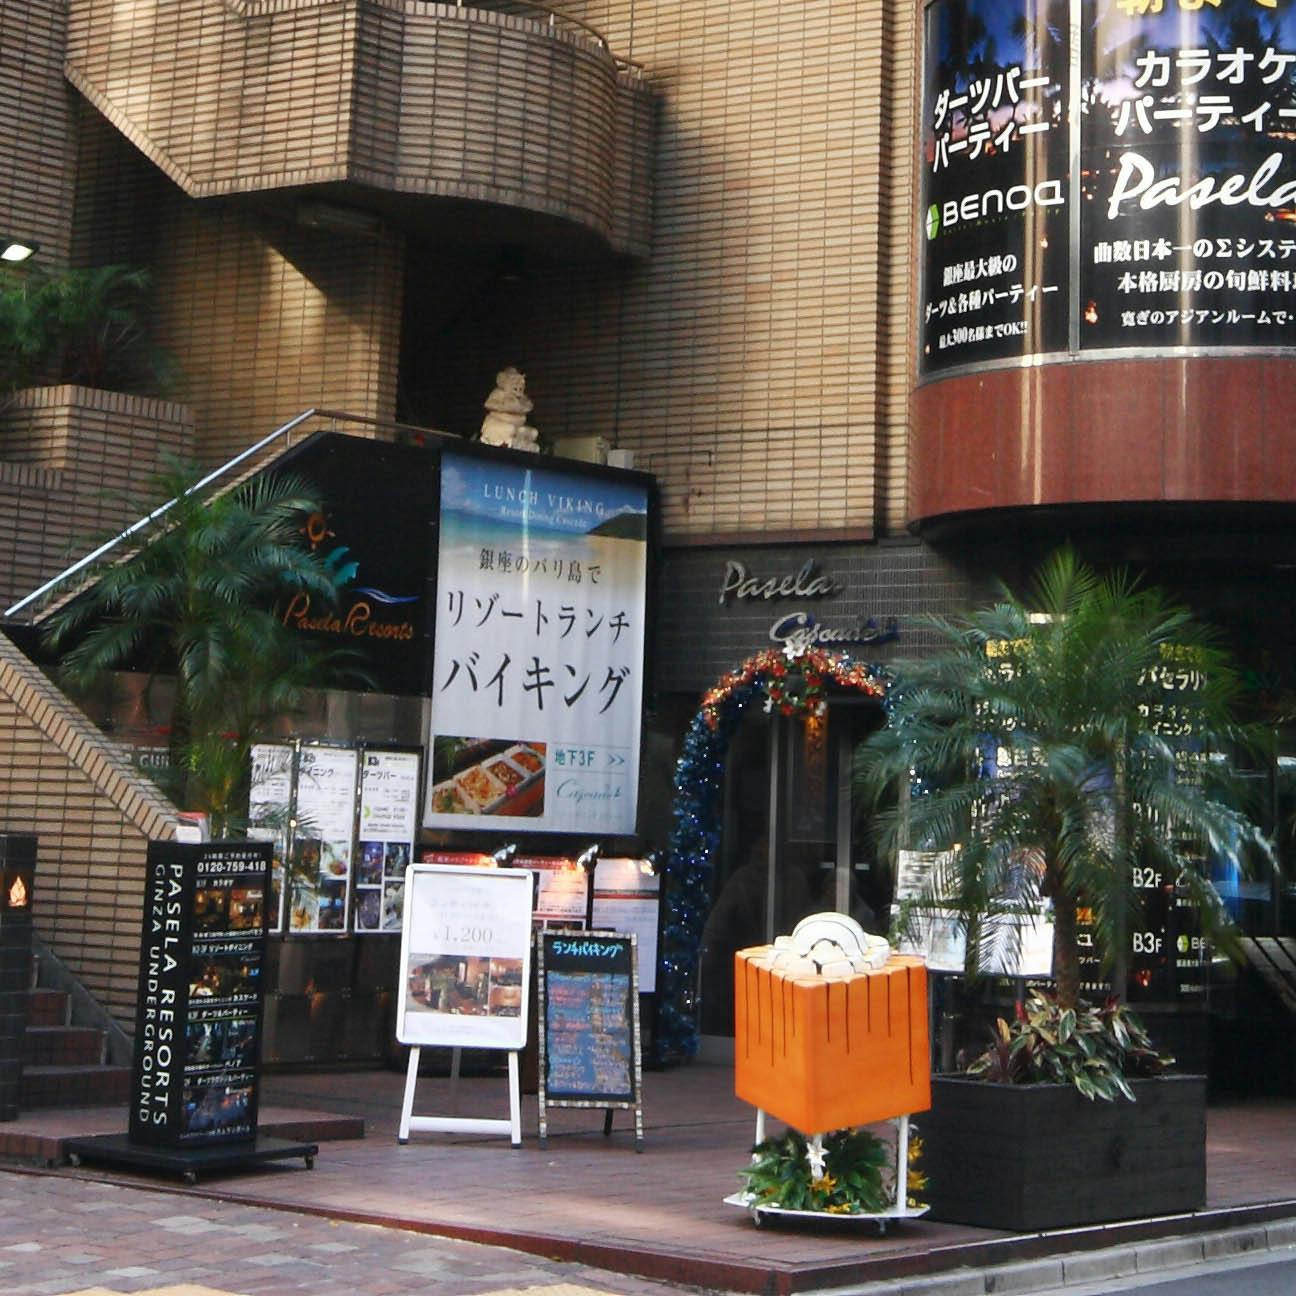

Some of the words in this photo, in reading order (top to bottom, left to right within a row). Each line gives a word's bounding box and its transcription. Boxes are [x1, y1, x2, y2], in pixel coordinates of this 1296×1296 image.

[933, 66, 1050, 131] ダーツバー
[932, 121, 1050, 173] パーティー
[943, 253, 1017, 288] 銀座最大級の
[484, 483, 539, 506] LUNCH
[548, 494, 604, 517] VIKING
[479, 547, 601, 584] 銀座のバリ島で
[719, 558, 837, 604] Pasela
[445, 590, 631, 644] リゾートランチ
[441, 651, 631, 715] バイキング
[151, 864, 165, 933] GINZA
[162, 864, 184, 973] PASELA
[1133, 932, 1163, 954] B3F
[139, 946, 160, 1122] UNDERGROUND
[153, 988, 176, 1125] RESORTS
